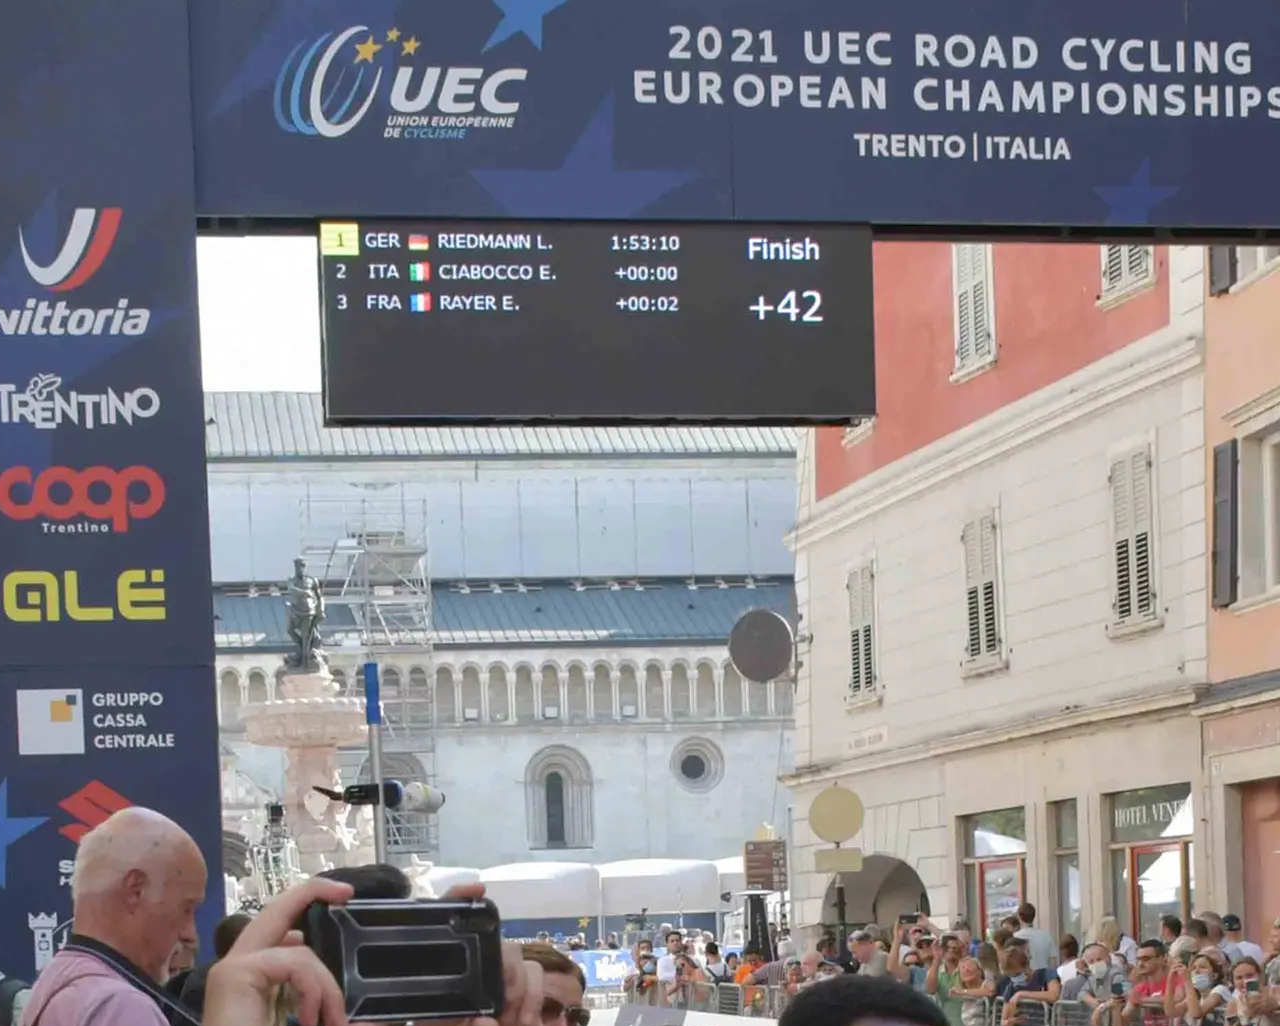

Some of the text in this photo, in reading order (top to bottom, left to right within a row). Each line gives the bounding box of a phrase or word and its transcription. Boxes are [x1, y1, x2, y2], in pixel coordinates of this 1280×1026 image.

[669, 26, 1251, 74] 2021 UEC ROAD CYCLING
[390, 67, 527, 113] UEC
[634, 64, 889, 109] EUROPEAN
[387, 116, 428, 126] UNION
[384, 127, 466, 138] DE CYCLISME
[854, 134, 1071, 160] TRENTO ITALIA
[337, 232, 679, 250] 1 GER RIEDMANN L. 1:53:10
[749, 237, 819, 260] Finish
[337, 264, 677, 280] 2 ITA CIABOCCO E. +00:00
[338, 295, 678, 311] 3 FRA RAYER E. +00:02
[750, 291, 823, 321] +42
[42, 522, 108, 532] Trentino
[92, 692, 163, 706] GRUPPO
[93, 714, 146, 727] CASSA
[94, 734, 174, 748] CENTRALE
